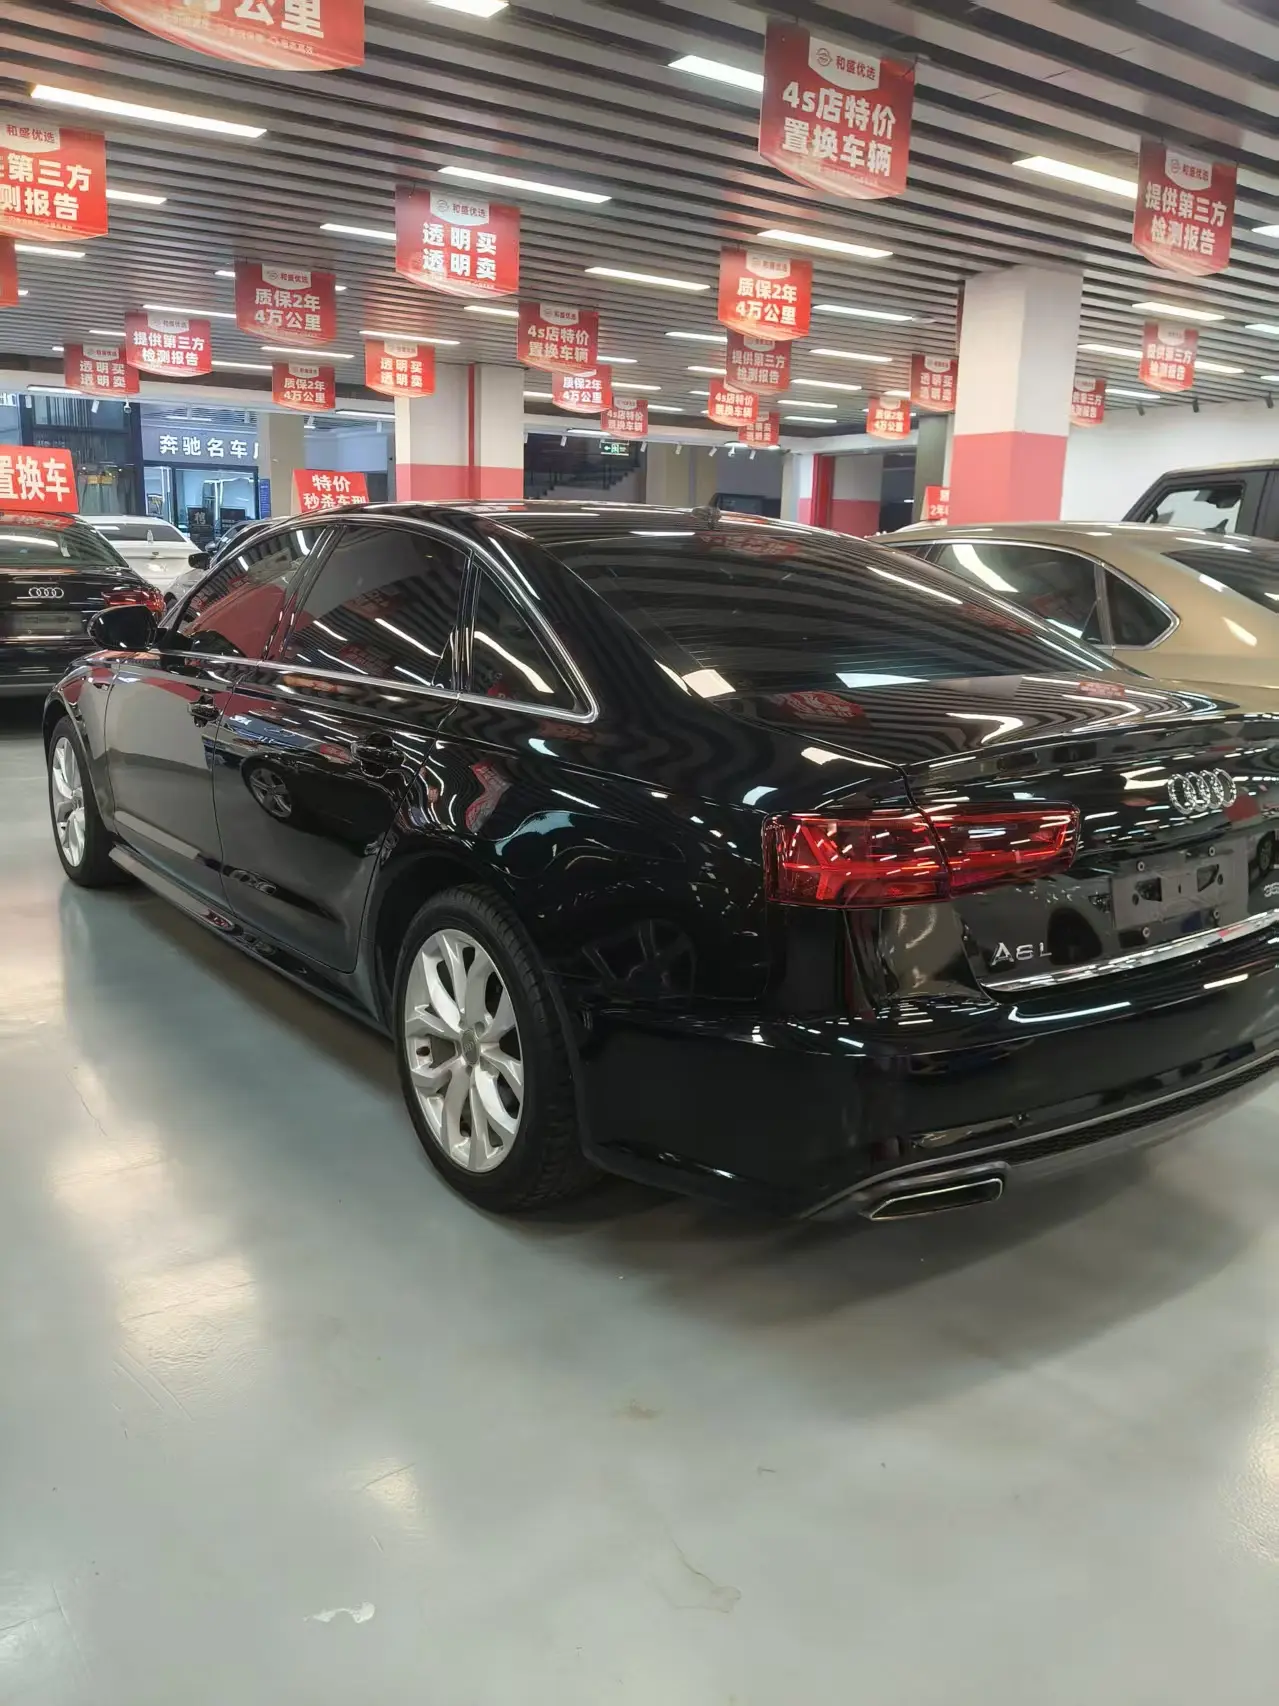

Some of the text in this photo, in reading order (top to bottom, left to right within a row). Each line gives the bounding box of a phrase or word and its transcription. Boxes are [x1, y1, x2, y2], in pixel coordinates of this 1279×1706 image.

[183, 0, 324, 38] 公里
[836, 55, 876, 81] 和盛优选
[782, 81, 896, 140] 4s店特价
[6, 124, 55, 143] 和盛优选
[782, 117, 892, 177] 置换车辆
[0, 153, 92, 191] 第三方
[1145, 181, 1227, 227] 提供第三方
[423, 222, 497, 256] 透明买
[1151, 215, 1215, 256] 检测报告
[423, 248, 497, 281] 透明卖
[255, 288, 320, 312] 质保2年
[737, 277, 797, 304] 质保2年
[254, 308, 321, 331] 4万公里
[736, 301, 796, 325] 4万公里
[133, 331, 204, 351] 提供第三方
[528, 325, 589, 346] 4s店特价
[142, 348, 198, 367] 检测报告
[529, 341, 588, 363] 置换车辆
[80, 360, 125, 375] 透明买
[380, 357, 422, 374] 透明买
[80, 373, 126, 388] 透明卖
[284, 377, 325, 392] 质保2年
[380, 371, 422, 388] 透明卖
[284, 390, 326, 404] 4万公里
[562, 390, 602, 404] 4万公里
[312, 474, 351, 492] 特价
